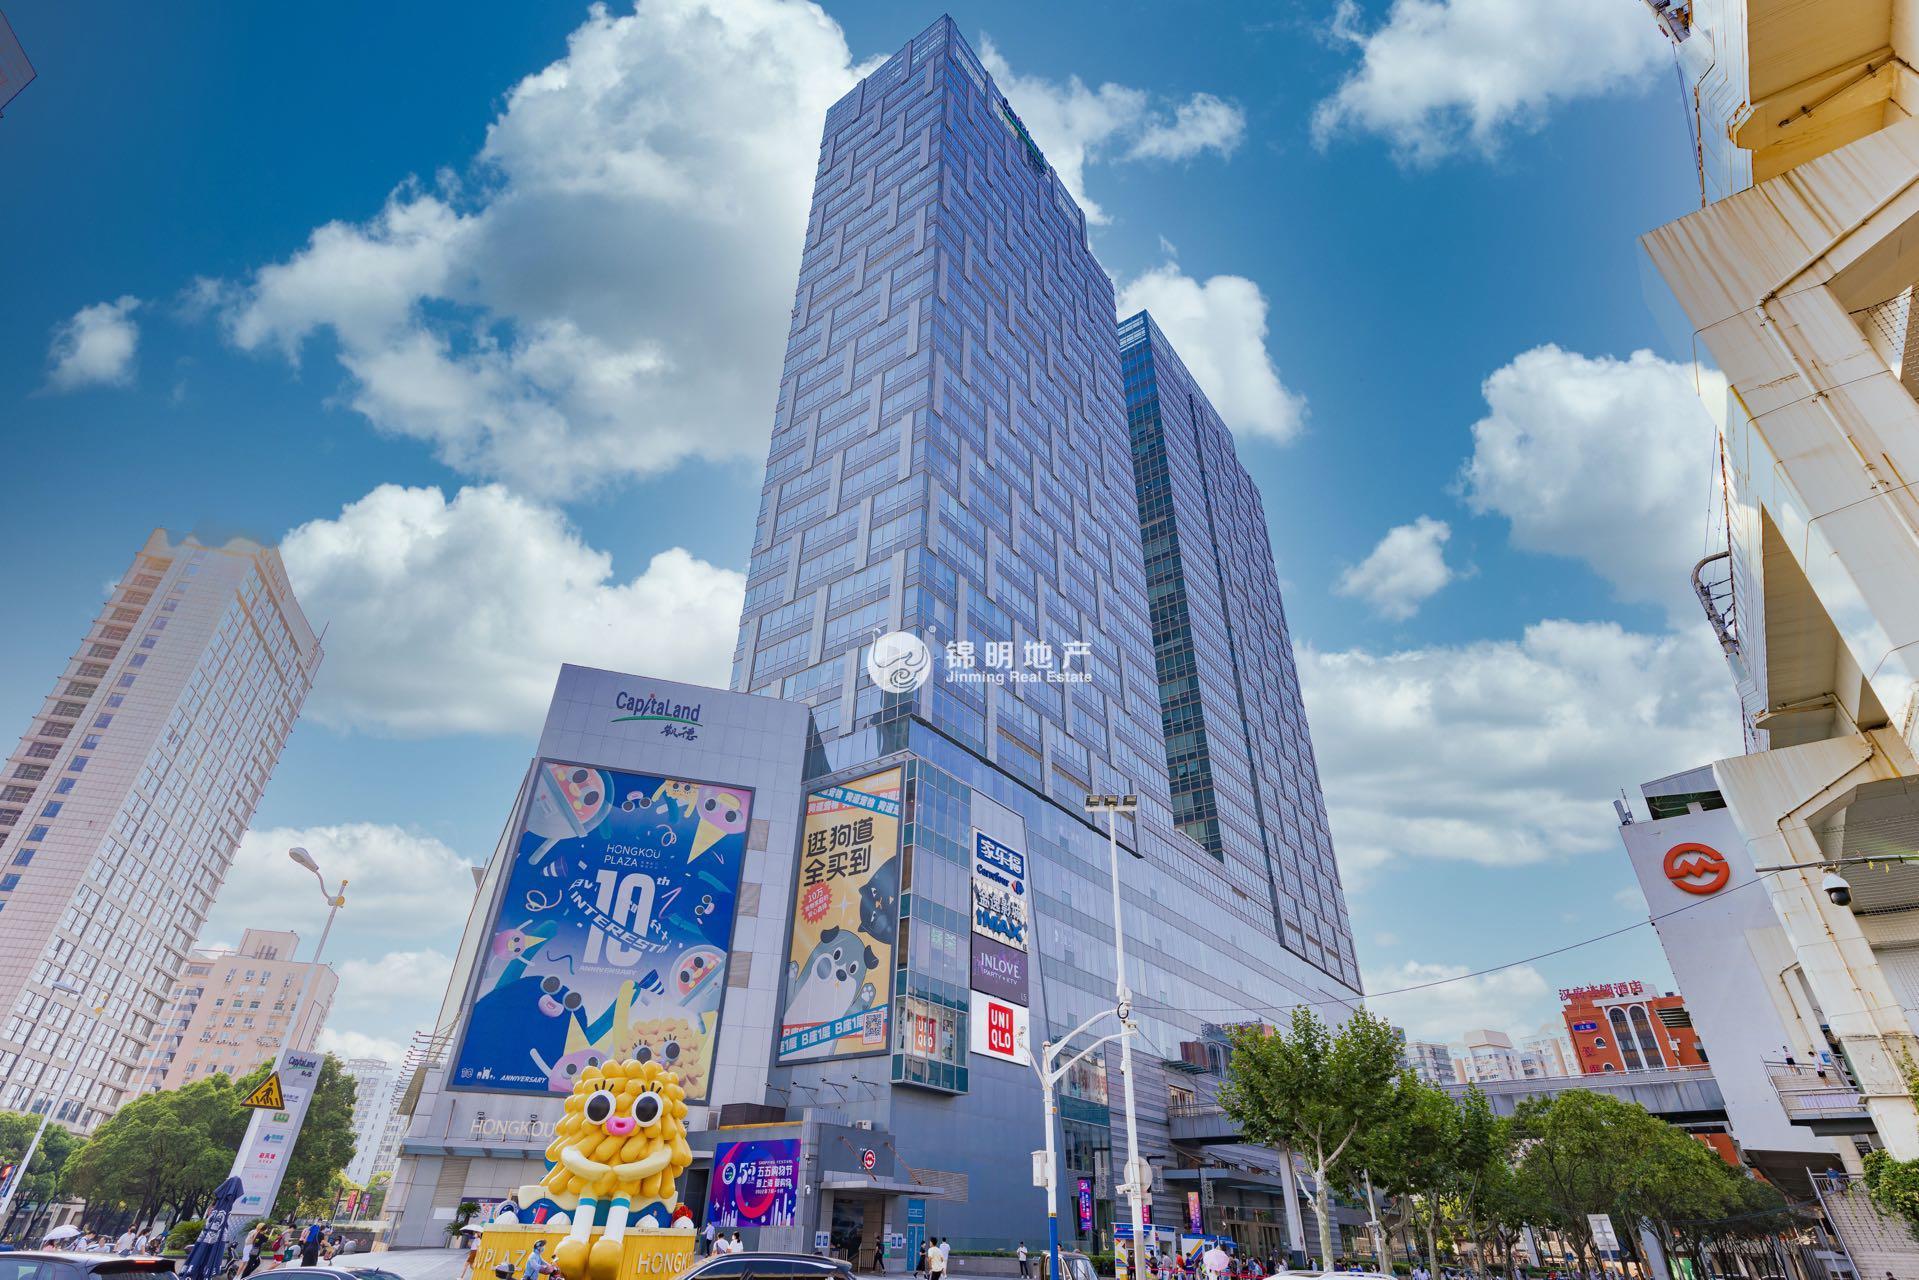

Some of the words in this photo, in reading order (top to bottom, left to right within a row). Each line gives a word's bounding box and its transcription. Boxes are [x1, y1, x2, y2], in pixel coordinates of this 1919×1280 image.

[616, 691, 701, 722] CapitaLand
[806, 816, 875, 858] 逛狗道
[604, 855, 638, 867] PLAZA
[606, 844, 661, 859] HONGKOU
[980, 838, 1021, 874] 家乐福
[803, 844, 872, 887] 全买到
[976, 906, 1023, 944] IMAX
[981, 952, 1020, 979] INLOVE
[983, 968, 1002, 980] PARTY
[1559, 980, 1643, 1001] 汉庭连锁酒店
[991, 1008, 1010, 1030] UNI
[991, 1030, 1011, 1049] QLO
[500, 1074, 547, 1084] ANNIVERSARY
[470, 1118, 556, 1138] HONGKOU
[757, 1165, 793, 1177] 五五购物节
